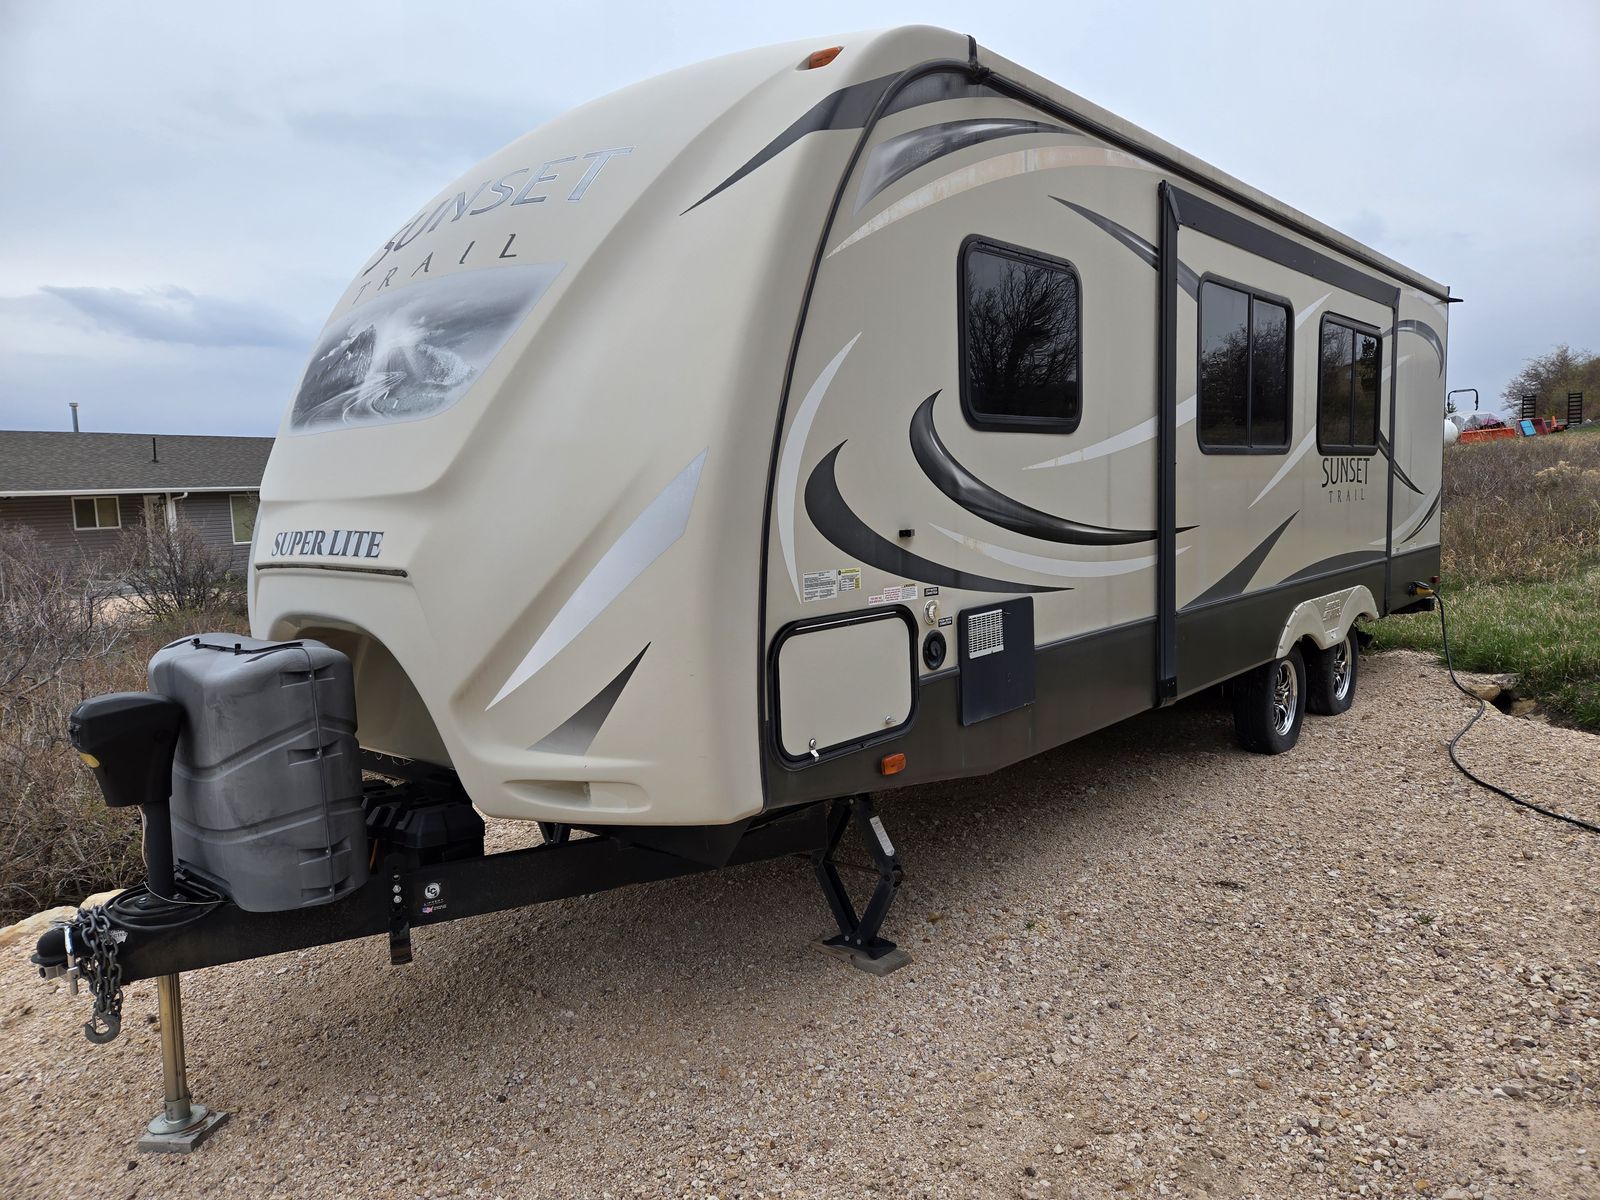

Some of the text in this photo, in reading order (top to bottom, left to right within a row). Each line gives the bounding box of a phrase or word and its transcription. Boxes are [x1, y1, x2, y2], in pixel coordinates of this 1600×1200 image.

[361, 146, 636, 278] SUNSET
[352, 233, 518, 305] TRAIL
[1321, 457, 1371, 488] SUNSET
[1328, 488, 1365, 504] TRAIL
[271, 529, 384, 559] SUPER LITE
